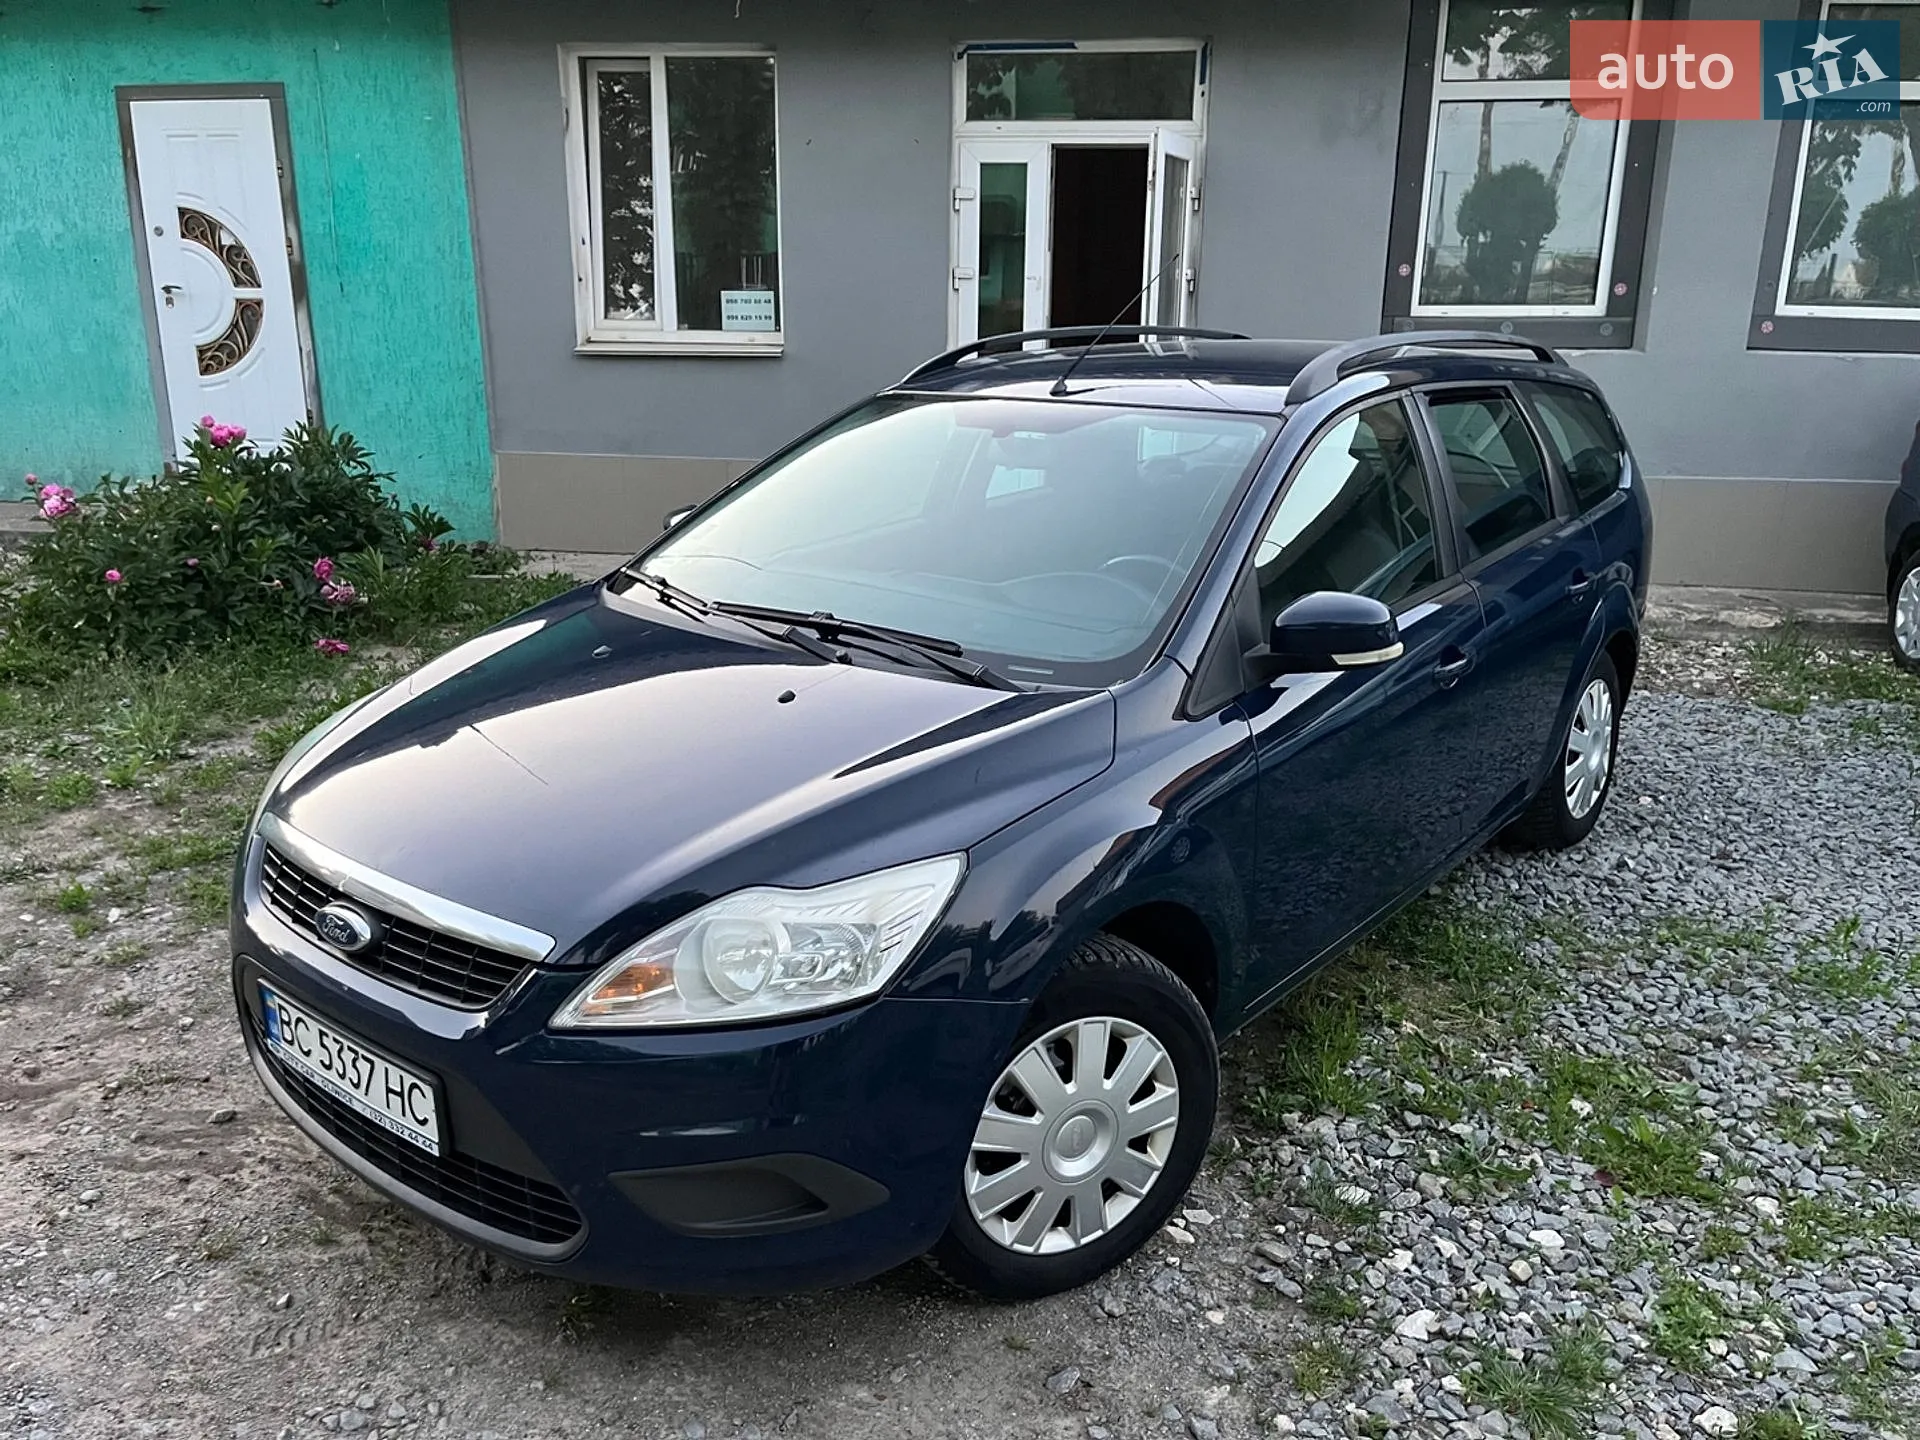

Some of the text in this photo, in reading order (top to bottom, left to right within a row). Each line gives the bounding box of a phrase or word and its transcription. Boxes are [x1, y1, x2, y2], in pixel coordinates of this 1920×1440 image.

[322, 914, 351, 943] Ford
[277, 1002, 430, 1127] BC 5337 HC
